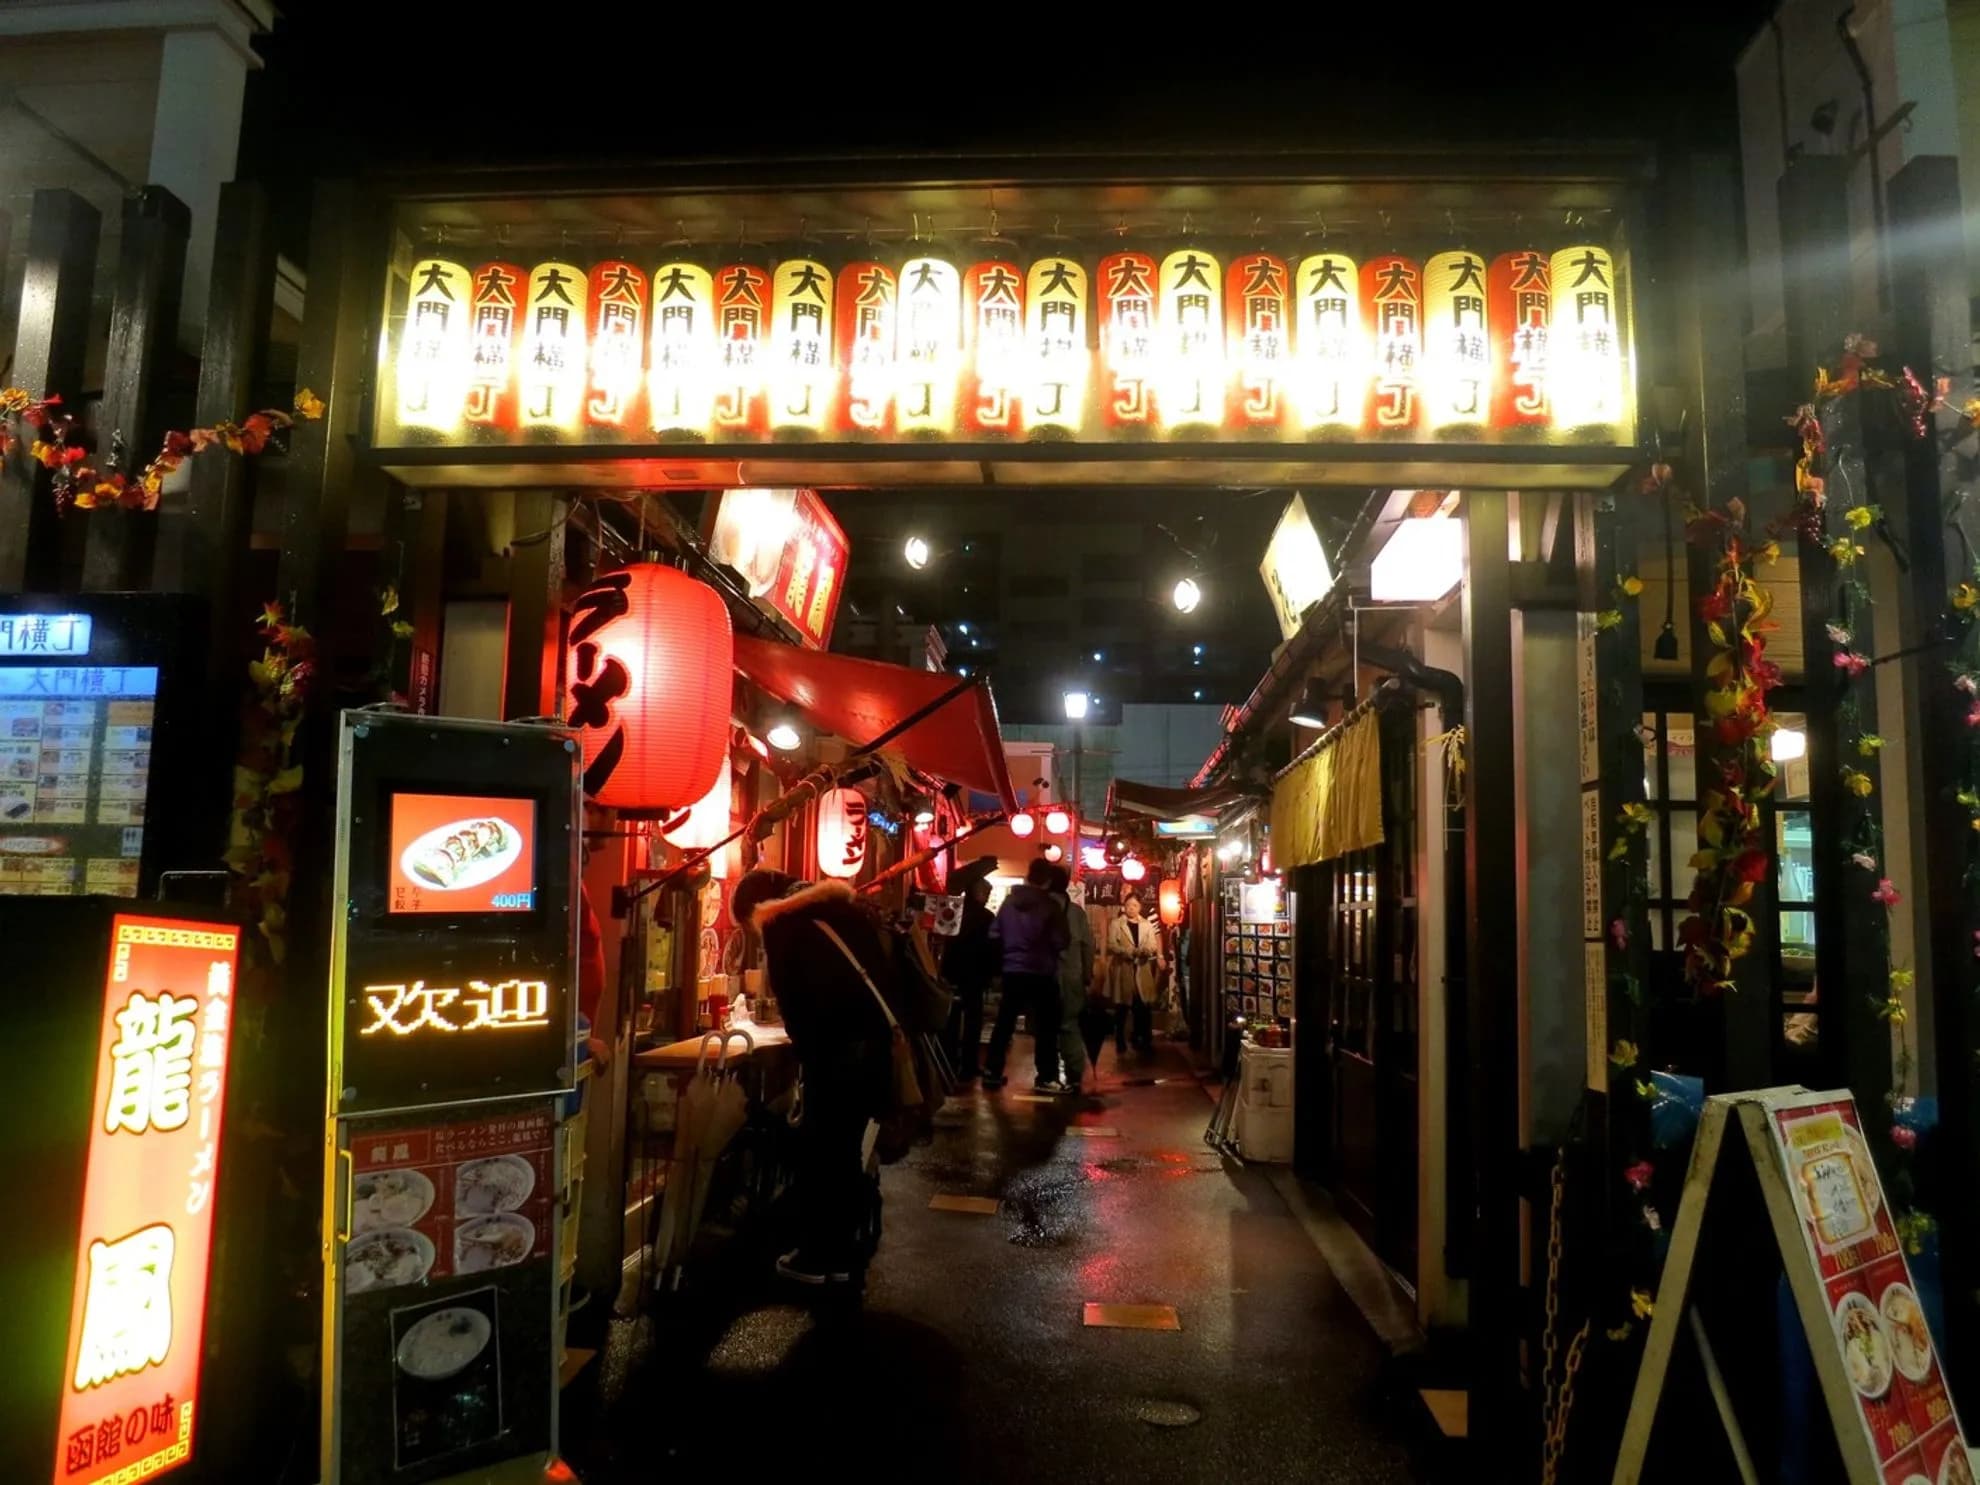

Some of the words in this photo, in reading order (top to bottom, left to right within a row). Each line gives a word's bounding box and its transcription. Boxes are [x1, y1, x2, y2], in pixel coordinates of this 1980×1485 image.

[467, 266, 516, 419] 大門横丁
[529, 268, 575, 418] 大門横丁
[592, 266, 640, 416] 大門丁
[719, 267, 762, 420] 大門横丁
[786, 264, 827, 416] 大門横丁
[851, 267, 893, 424] 大門丁
[907, 262, 944, 417] 大横丁
[978, 267, 1019, 422] 大門丁
[1309, 259, 1348, 417] 大門丁
[1375, 262, 1418, 423] 大門横丁
[1449, 256, 1486, 414] 大門横丁
[1571, 249, 1611, 409] 大門横
[27, 669, 132, 694] 大門横丁
[491, 893, 531, 909] 400円
[360, 980, 550, 1034] 欢迎
[66, 1392, 175, 1475] 函館の味
